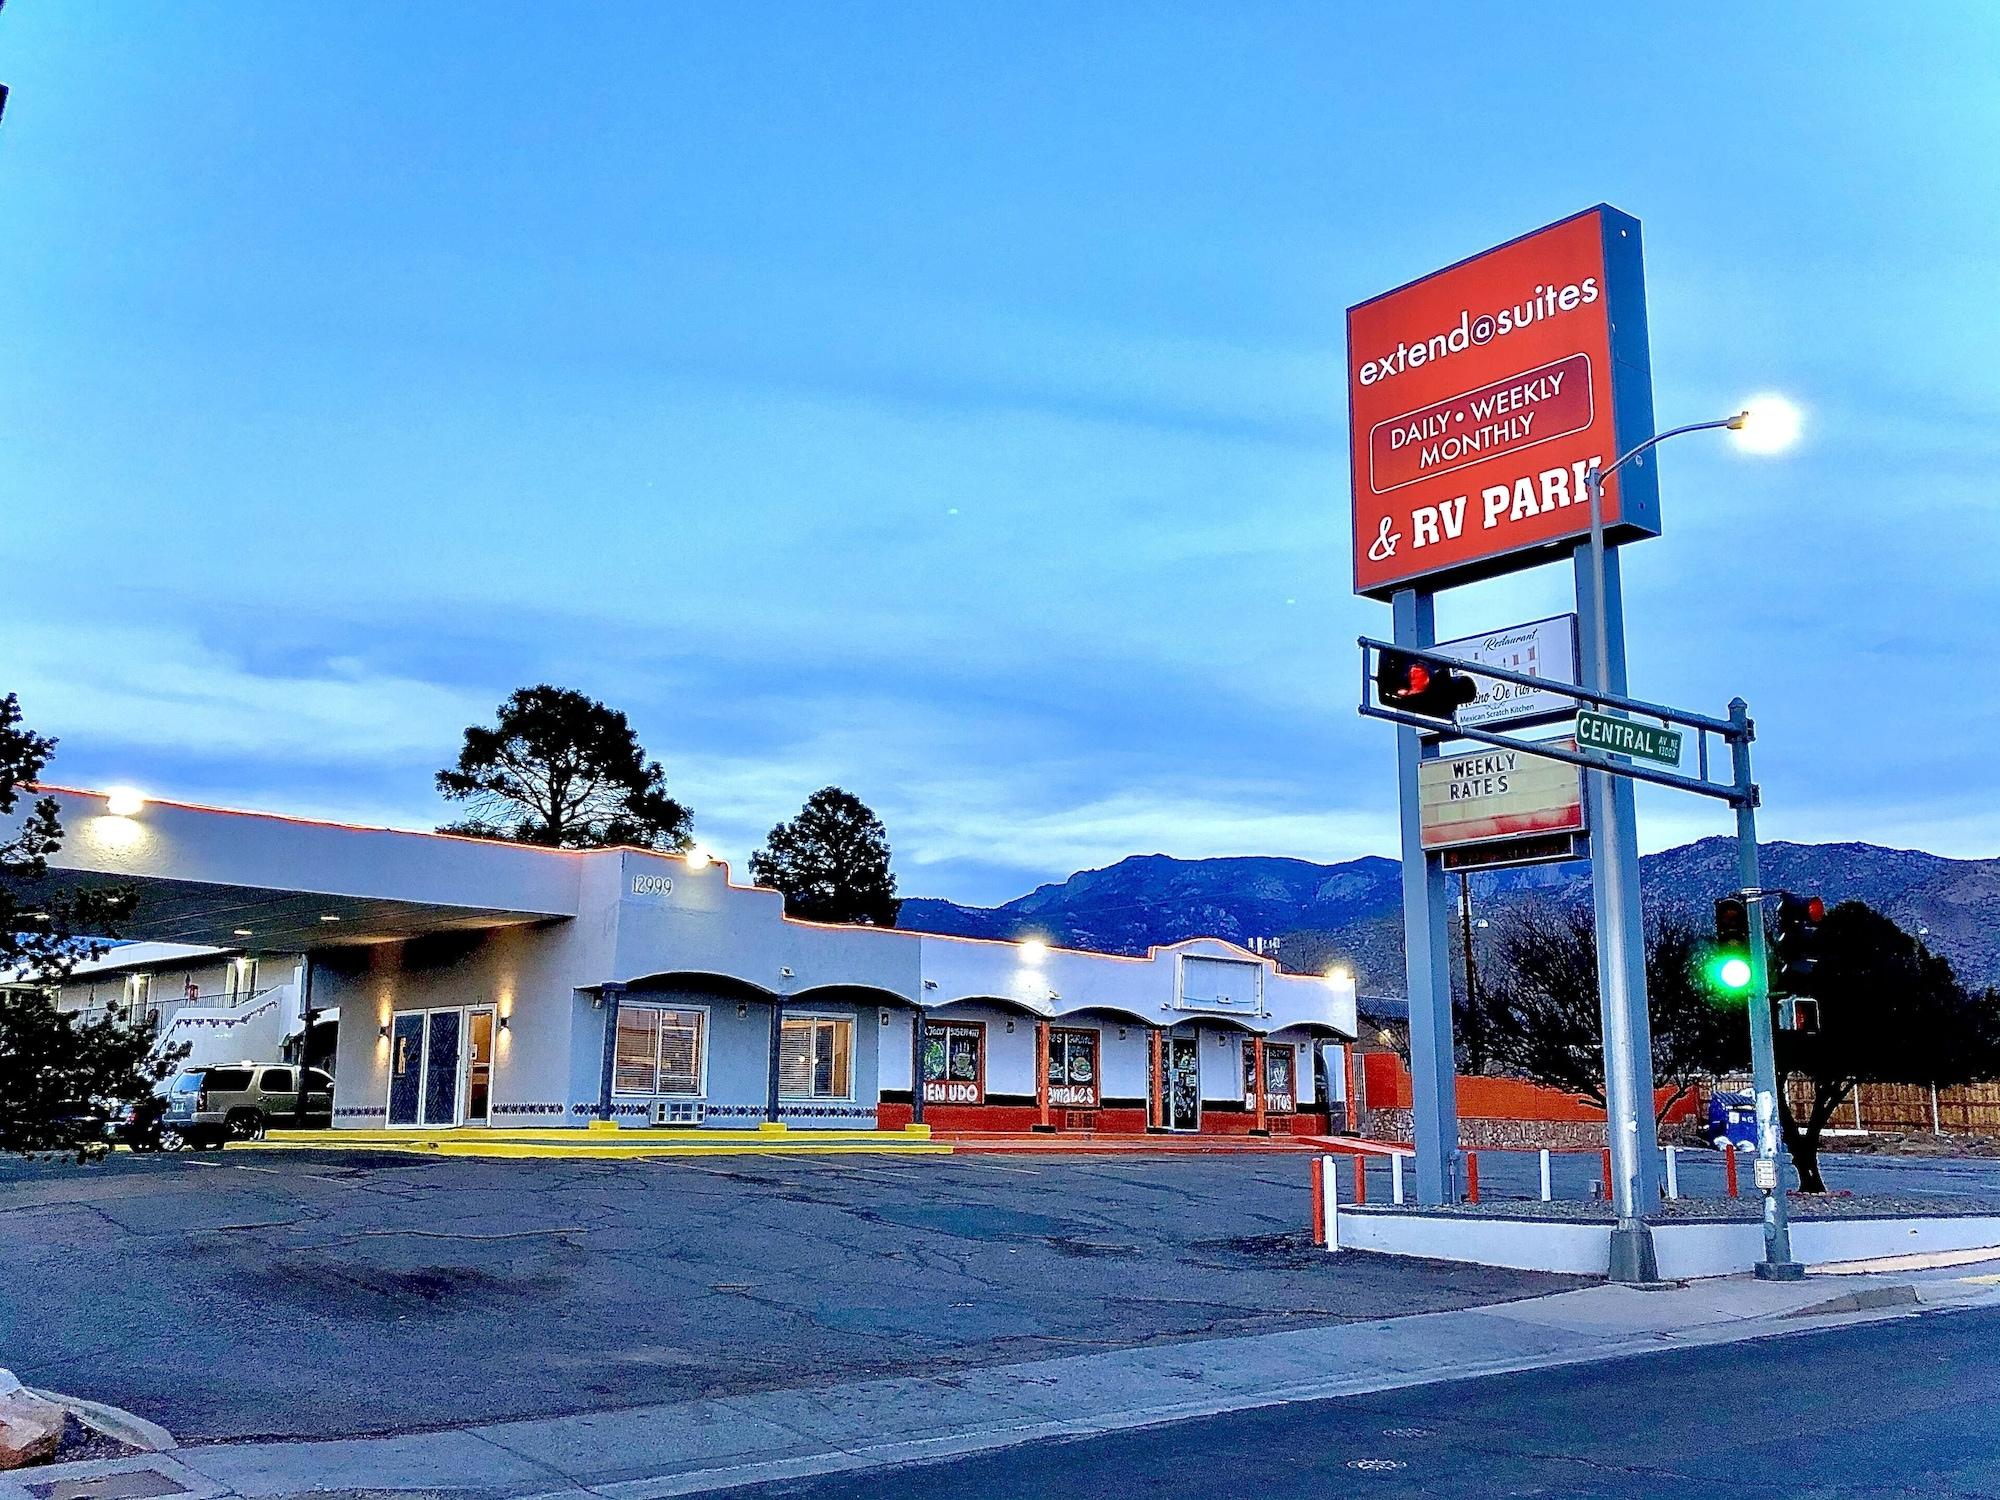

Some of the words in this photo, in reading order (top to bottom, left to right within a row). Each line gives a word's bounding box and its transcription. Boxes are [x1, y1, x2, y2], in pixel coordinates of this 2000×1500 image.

[1391, 411, 1450, 450] DAILY
[1470, 371, 1565, 422] WEEKLY
[1420, 411, 1535, 469] MONTHLY
[1368, 516, 1402, 562] &
[1412, 496, 1467, 549] RV
[1484, 628, 1538, 652] Restaurant
[1493, 683, 1511, 701] De
[1460, 712, 1486, 723] Mexican
[1486, 707, 1510, 718] Scratch
[1511, 703, 1535, 713] Kitchen
[1580, 717, 1654, 753] CENTRAL
[1658, 736, 1668, 745] AV
[1452, 752, 1517, 779] WEEKLY
[1450, 775, 1509, 800] RATES
[632, 874, 672, 897] 12999
